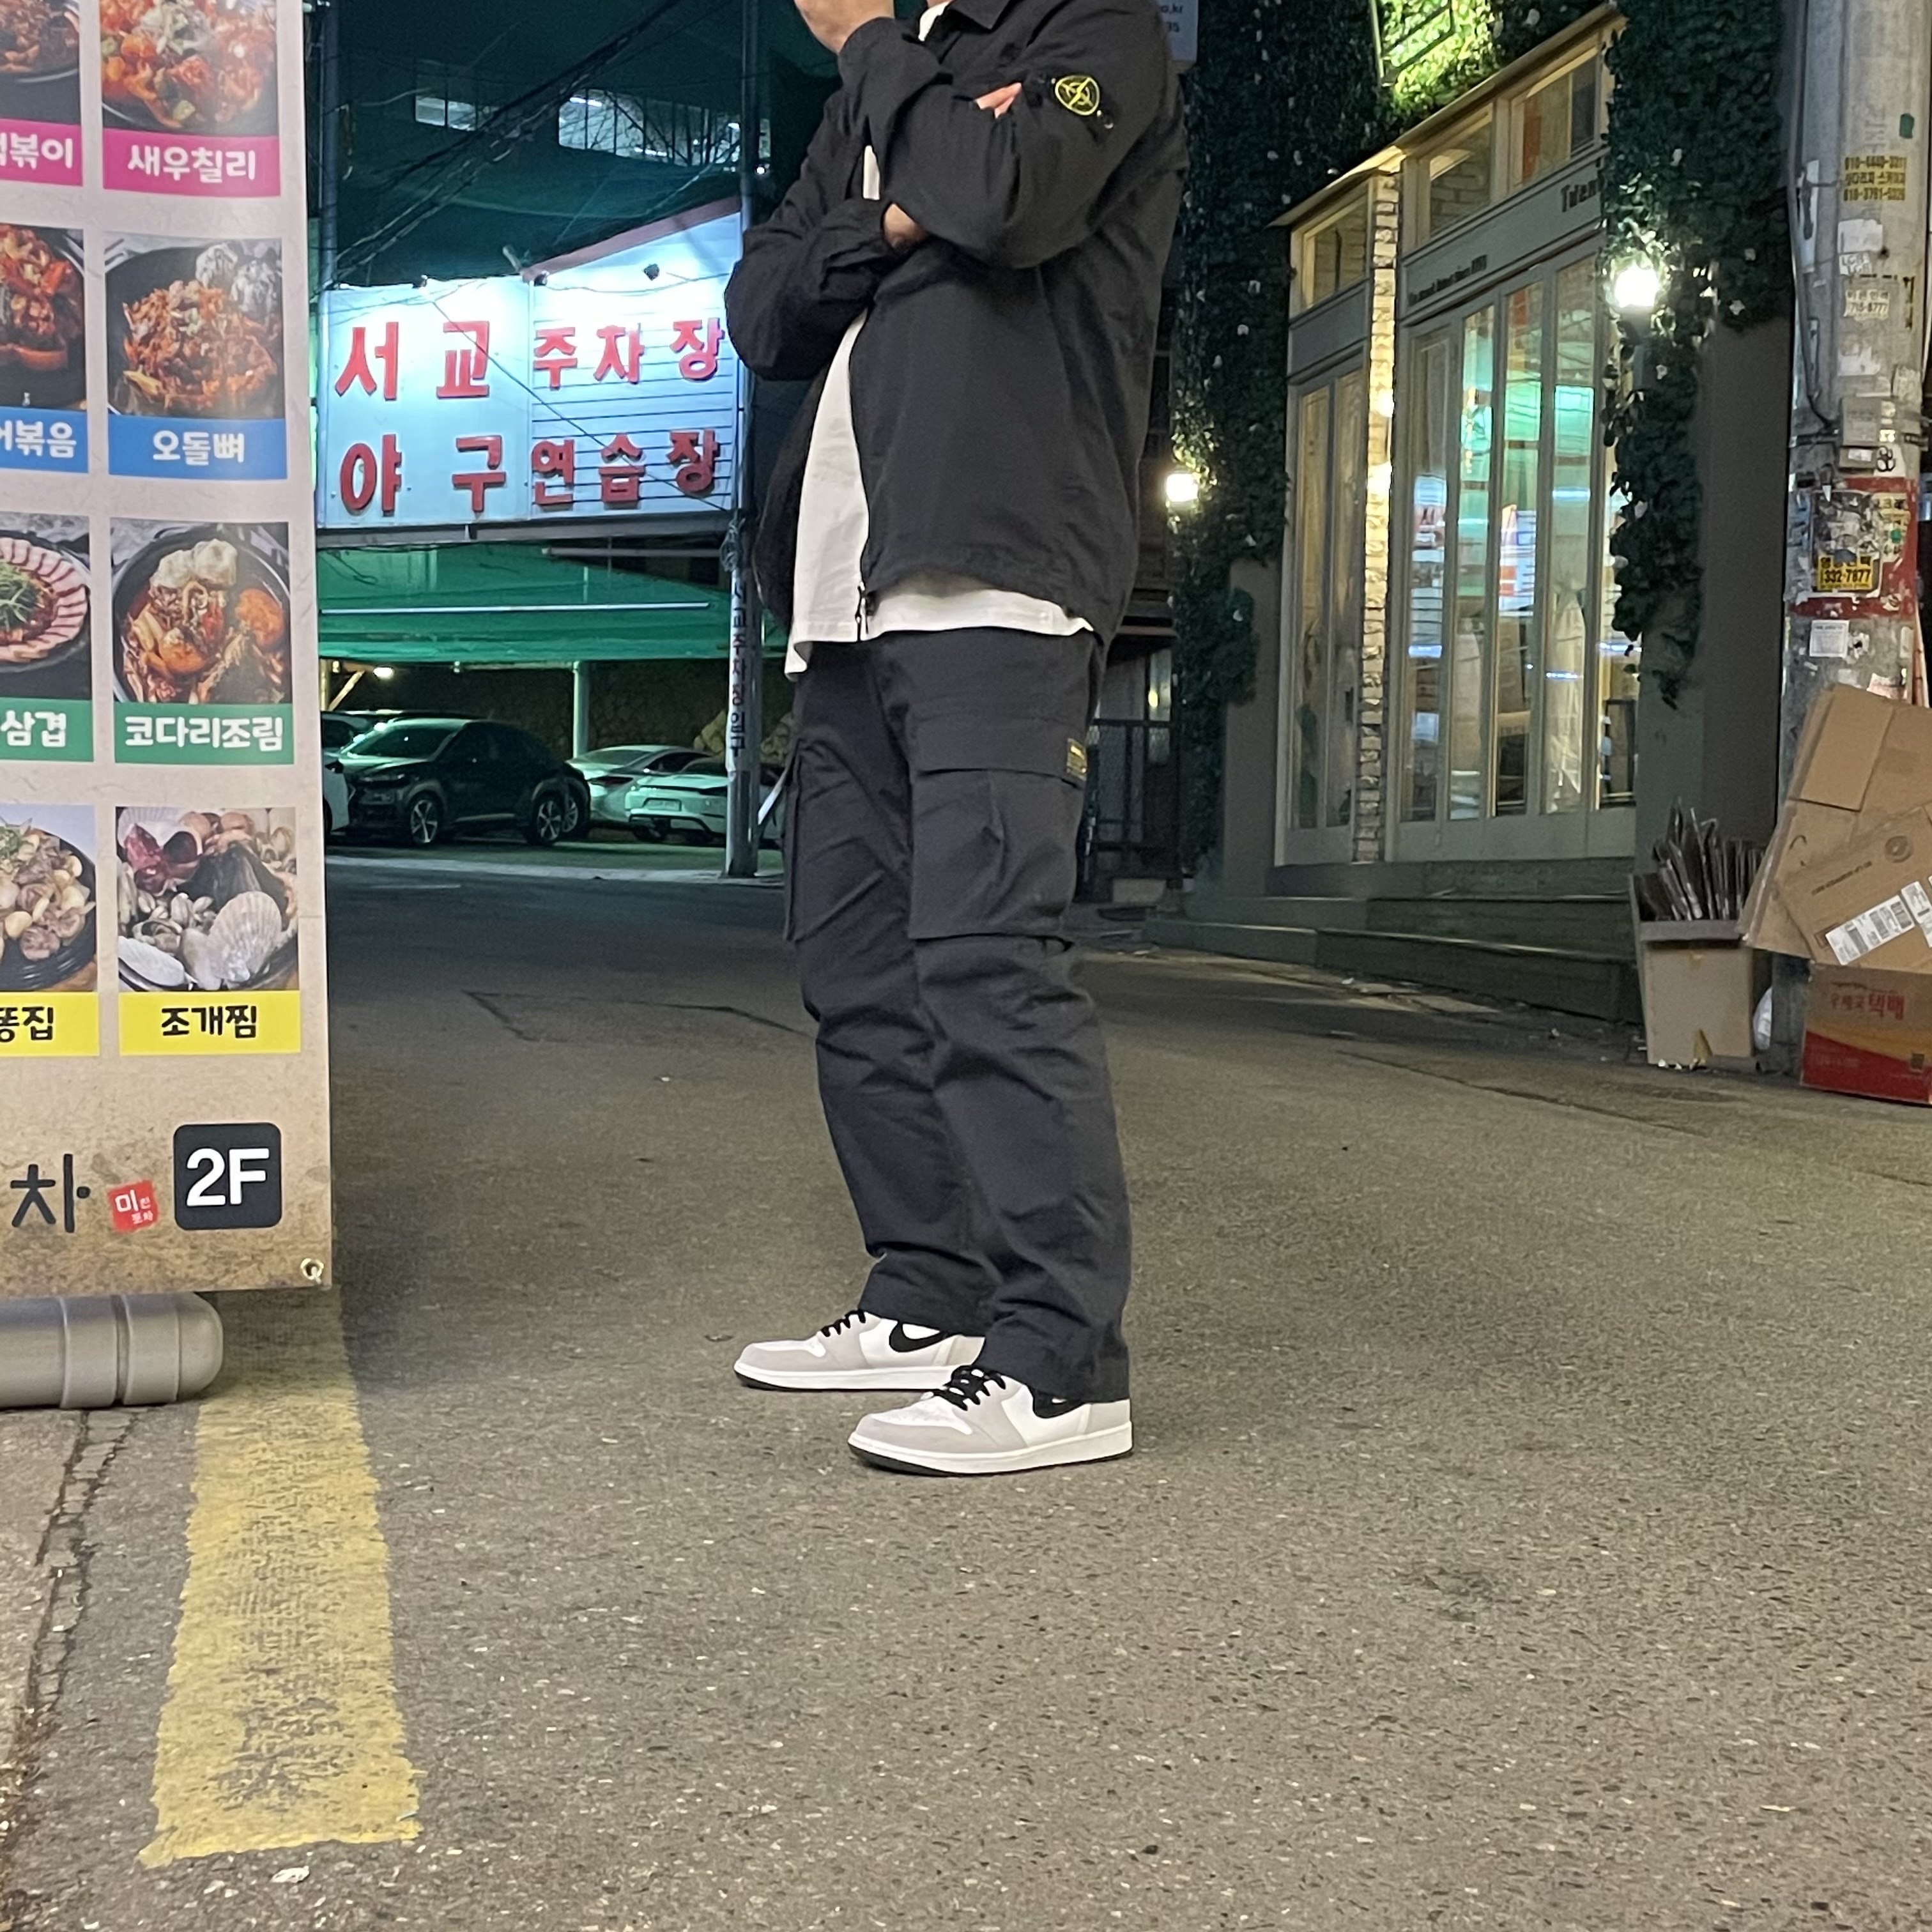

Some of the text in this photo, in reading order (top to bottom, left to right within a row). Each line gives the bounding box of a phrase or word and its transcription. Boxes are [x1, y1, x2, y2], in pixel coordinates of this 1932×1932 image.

[0, 132, 73, 169] 볶이
[127, 144, 256, 183] 새우칠리
[153, 431, 245, 465] 오돌뼈
[0, 710, 66, 748] 삼겹
[125, 716, 284, 753] 코다리조림
[161, 1005, 257, 1039] 조개찜
[10, 1153, 91, 1233] 차
[186, 1147, 270, 1208] 2F
